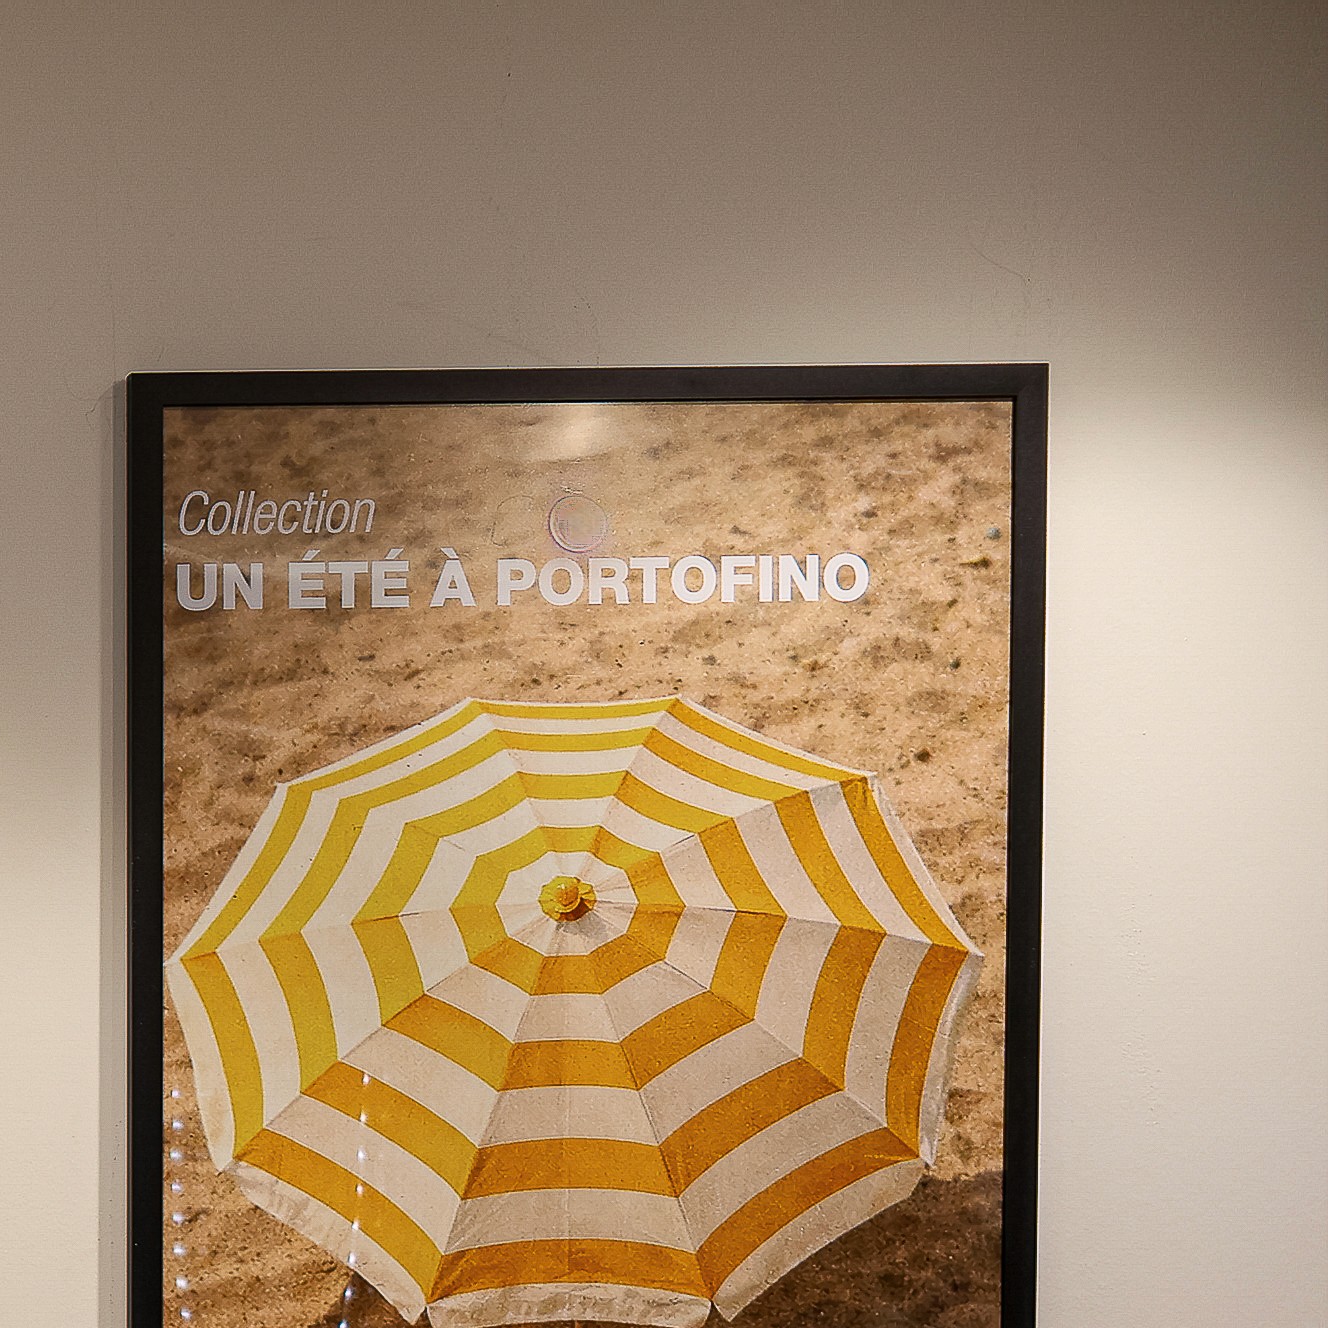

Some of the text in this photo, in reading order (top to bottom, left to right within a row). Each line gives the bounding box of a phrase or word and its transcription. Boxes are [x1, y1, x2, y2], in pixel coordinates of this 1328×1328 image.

[177, 490, 376, 536] Collection
[175, 547, 872, 611] UN ÉTÉ À PORTOFINO
